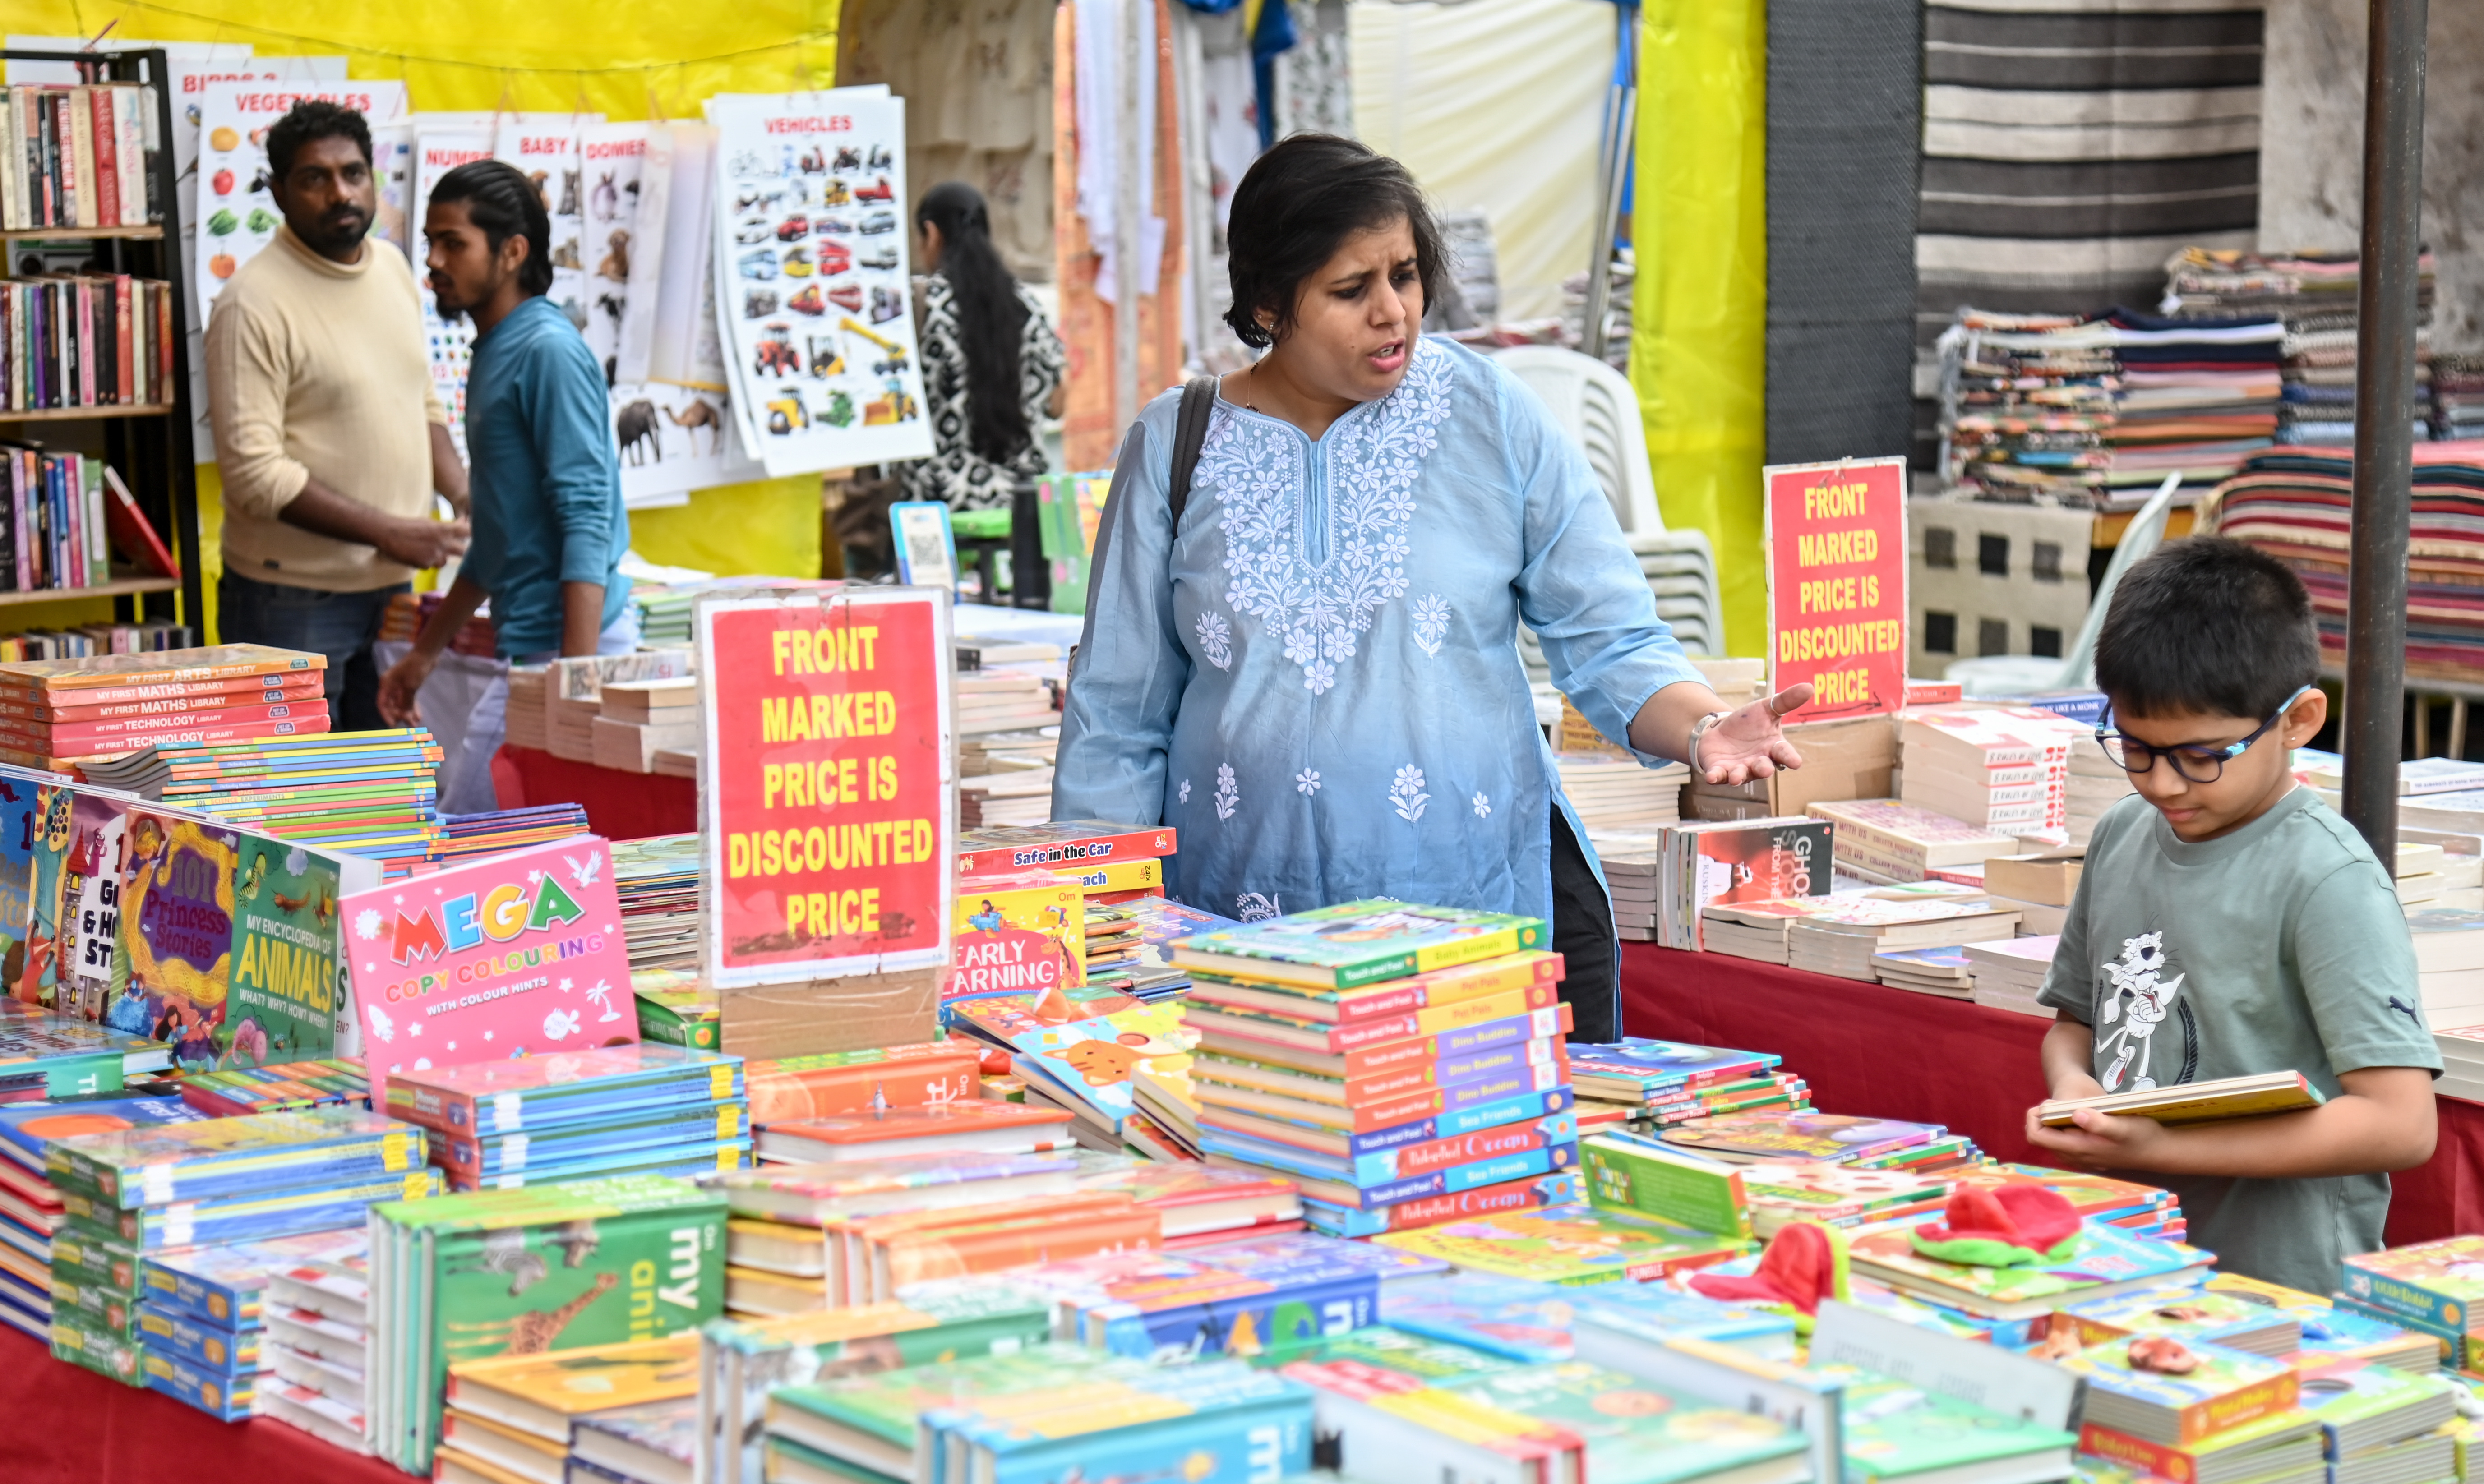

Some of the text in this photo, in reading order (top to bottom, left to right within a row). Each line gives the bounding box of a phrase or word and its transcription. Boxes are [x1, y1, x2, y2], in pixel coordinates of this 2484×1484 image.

[764, 116, 853, 135] VEHICLES
[520, 137, 568, 154] BABY
[1805, 483, 1868, 520] FRONT
[1798, 529, 1878, 567] MARKED
[1800, 575, 1879, 614] PRICE IS
[772, 626, 878, 676] FRONT
[1780, 619, 1900, 663] DISCOUNTED
[126, 665, 255, 683] MY FIRST ARTS LIBRARY
[97, 682, 223, 700] MY FIRST MATHS LIBRARY
[1814, 668, 1869, 705] PRICE
[100, 697, 226, 716] MY FIRST MATHS LIBRARY
[761, 691, 896, 743] MARKED
[2055, 702, 2100, 712] LIKE A MONK
[124, 715, 195, 730] TECHNOLOGY
[106, 741, 125, 749] FIRST
[126, 731, 204, 748] TECHNOLOGY
[206, 731, 233, 739] LIBRARY
[764, 756, 898, 809] PRICE IS
[240, 793, 285, 802] EXPERIMENTS
[729, 818, 933, 879] DISCOUNTED
[1839, 823, 1856, 837] WITH
[1858, 829, 1867, 840] US
[1873, 835, 1893, 848] COLLEEN
[1894, 843, 1913, 854] HOOVER
[1014, 842, 1112, 866] Safe in the Car
[1834, 842, 1911, 876] WITH US COLLEEN HOOVER
[172, 854, 213, 903] 101
[1083, 872, 1107, 886] ach
[1770, 837, 1782, 899] FROM THE
[1058, 892, 1076, 902] Om
[83, 910, 96, 935] &
[144, 889, 226, 936] Princess
[390, 871, 586, 966] MEGA
[787, 888, 880, 939] PRICE
[155, 921, 212, 959] Stories
[246, 914, 331, 954] MY ENCYCLOPEDIA OF
[956, 939, 1026, 969] EARLY
[1434, 940, 1502, 962] Baby Animals
[235, 933, 332, 1014] ANIMALS
[384, 933, 603, 1004] COPY COLOURING
[952, 960, 1055, 993] ARNING
[1344, 960, 1404, 982] Touch and Feel
[1462, 977, 1501, 991] Pet Pals
[426, 976, 548, 1017] WITH COLOUR HINTS
[1349, 994, 1413, 1016] Touch and Feel
[239, 988, 328, 1028] WHAT? WHY? HOW? WHEN?
[1453, 1004, 1492, 1019] Pet Pals
[1451, 1027, 1518, 1049] Dino Buddies
[1448, 1054, 1514, 1076] Dino Buddies
[959, 1074, 970, 1096] Om
[1652, 1080, 1668, 1088] Cutout
[1697, 1071, 1715, 1079] Dolphin
[1649, 1086, 1681, 1097] Cutout Books
[1653, 1097, 1672, 1105] Cutout
[1661, 1097, 1729, 1114] Cutout Books Zebra
[1690, 1110, 1706, 1118] Books
[1458, 1106, 1522, 1128] Sea Friends
[1359, 1128, 1422, 1150] Touch and Feel
[1466, 1161, 1528, 1183] Sea Friends
[1369, 1182, 1431, 1203] Touch and Feel
[658, 1227, 701, 1310] my
